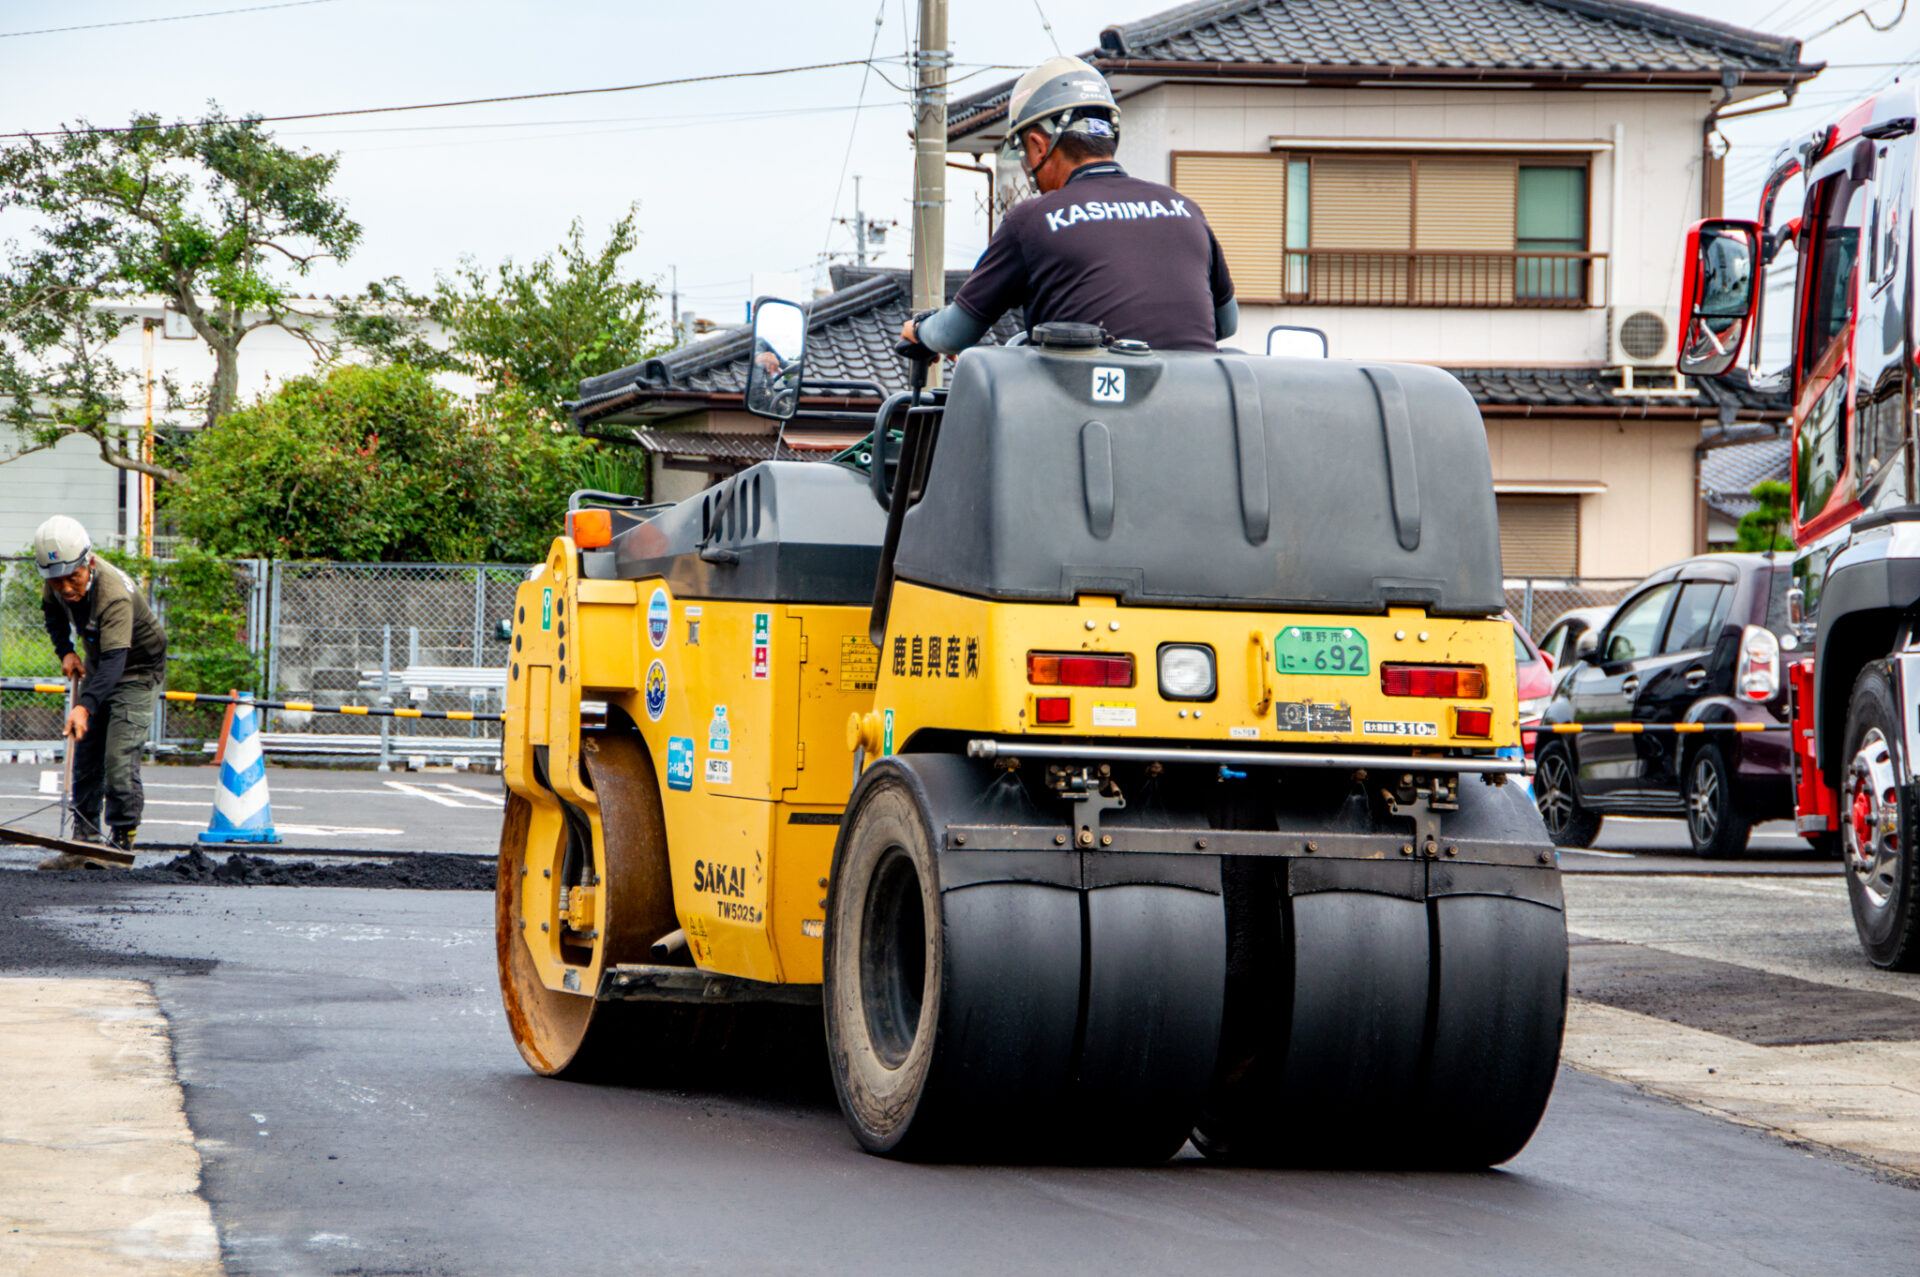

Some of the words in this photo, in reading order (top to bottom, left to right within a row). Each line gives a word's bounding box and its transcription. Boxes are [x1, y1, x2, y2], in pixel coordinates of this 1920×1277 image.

[1046, 199, 1191, 232] KASHIMA.K
[1097, 371, 1120, 397] 水
[709, 759, 728, 774] NETIS
[694, 859, 745, 898] SAKAI
